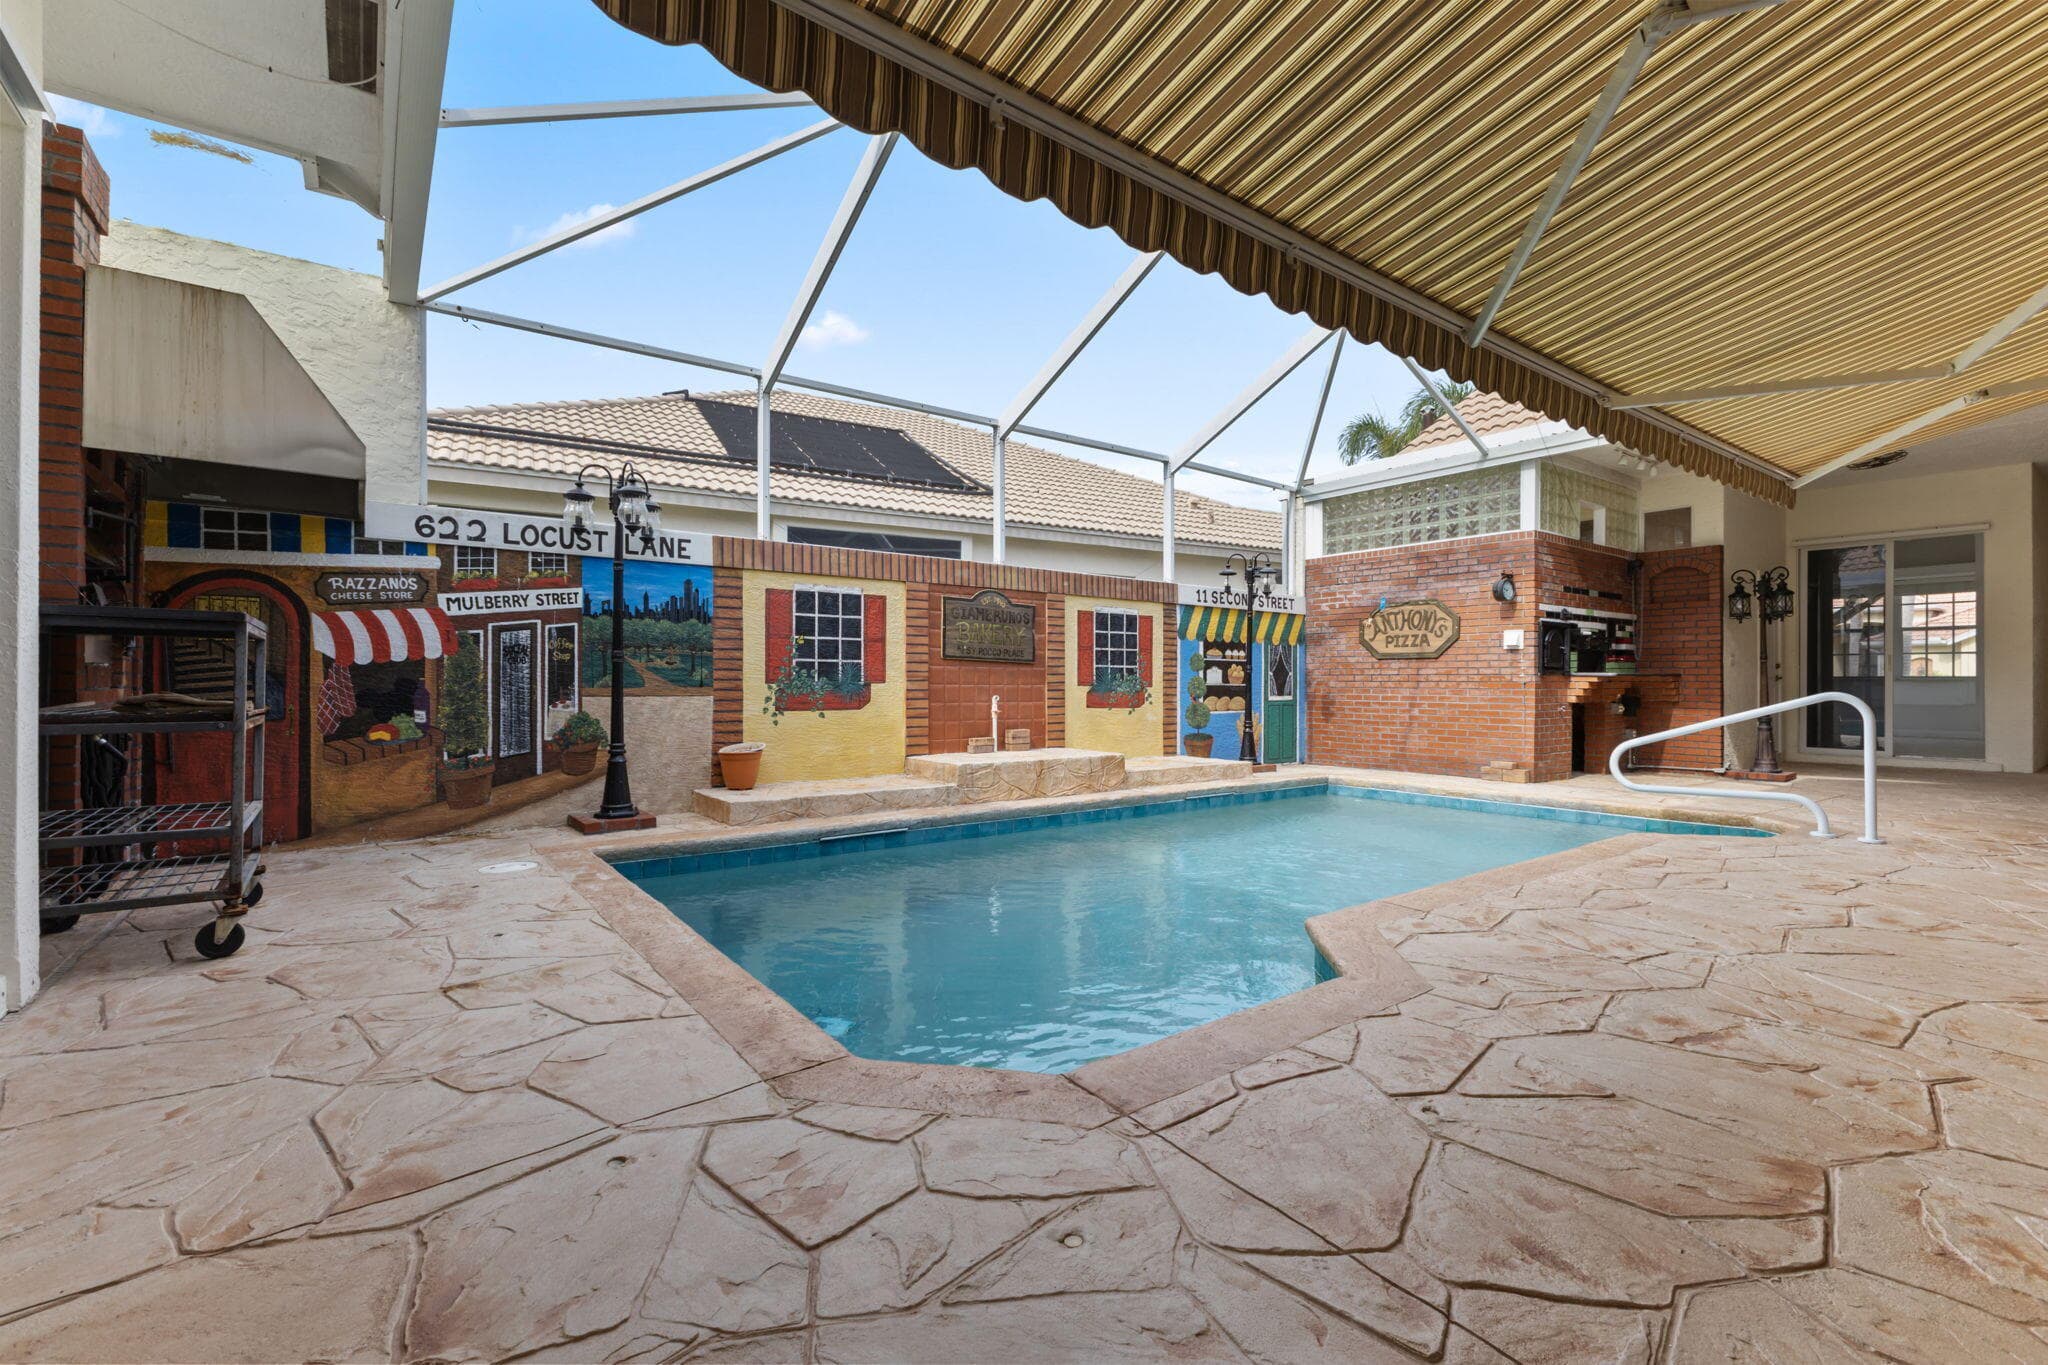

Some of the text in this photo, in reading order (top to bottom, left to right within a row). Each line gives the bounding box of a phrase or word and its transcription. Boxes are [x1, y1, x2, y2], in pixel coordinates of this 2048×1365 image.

[414, 514, 692, 561] 622 LOCUST LANE
[330, 591, 413, 600] CHEESE STORE
[446, 591, 580, 611] MULBERRY STREET
[1196, 589, 1295, 611] 11 SECON STREET
[955, 621, 1026, 645] BAKERY
[1385, 633, 1431, 648] PIZZA
[552, 650, 571, 664] Shop
